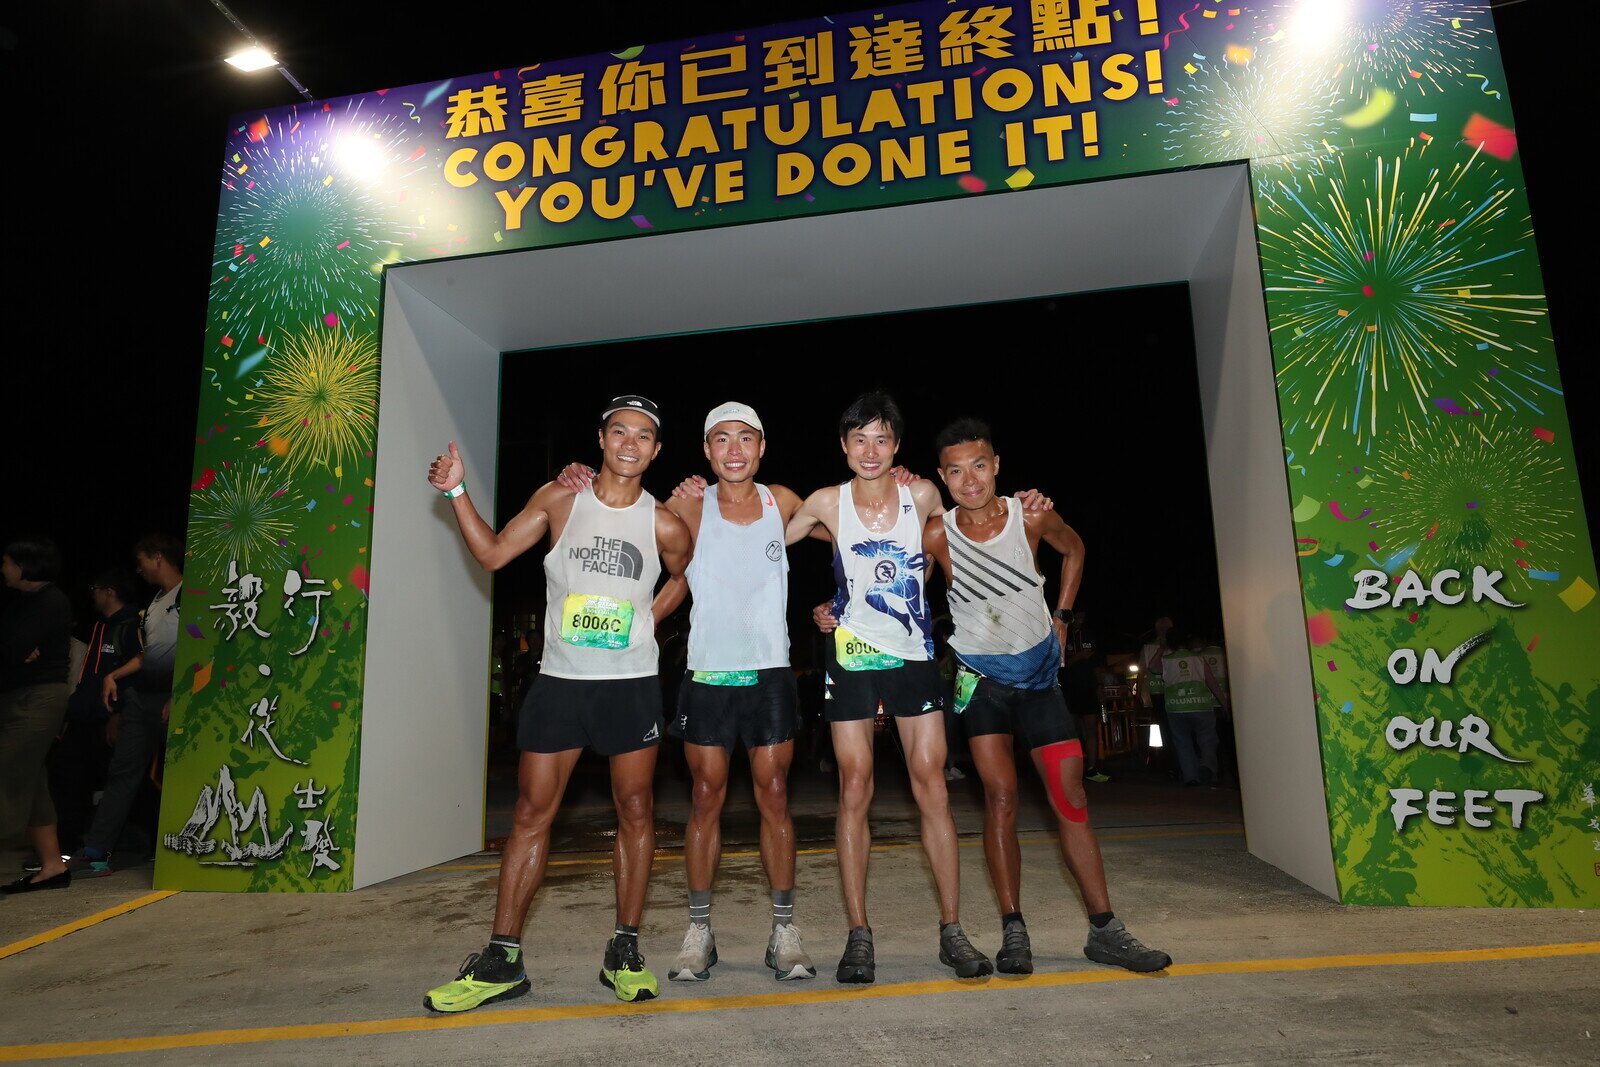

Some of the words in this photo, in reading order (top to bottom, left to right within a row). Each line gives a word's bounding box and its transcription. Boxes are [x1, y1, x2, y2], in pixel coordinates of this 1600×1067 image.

[444, 50, 1163, 189] CONGRATULATIONS!
[495, 160, 744, 230] YOU'VE
[776, 129, 971, 196] DONE
[1005, 111, 1098, 167] IT!
[569, 548, 620, 563] NORTH
[594, 536, 621, 551] THE
[582, 560, 617, 576] FACE
[1345, 566, 1526, 609] BACK
[572, 614, 621, 632] 8006C
[1387, 627, 1494, 684] ON
[1385, 713, 1530, 764] OUR
[1389, 788, 1544, 832] FEET
